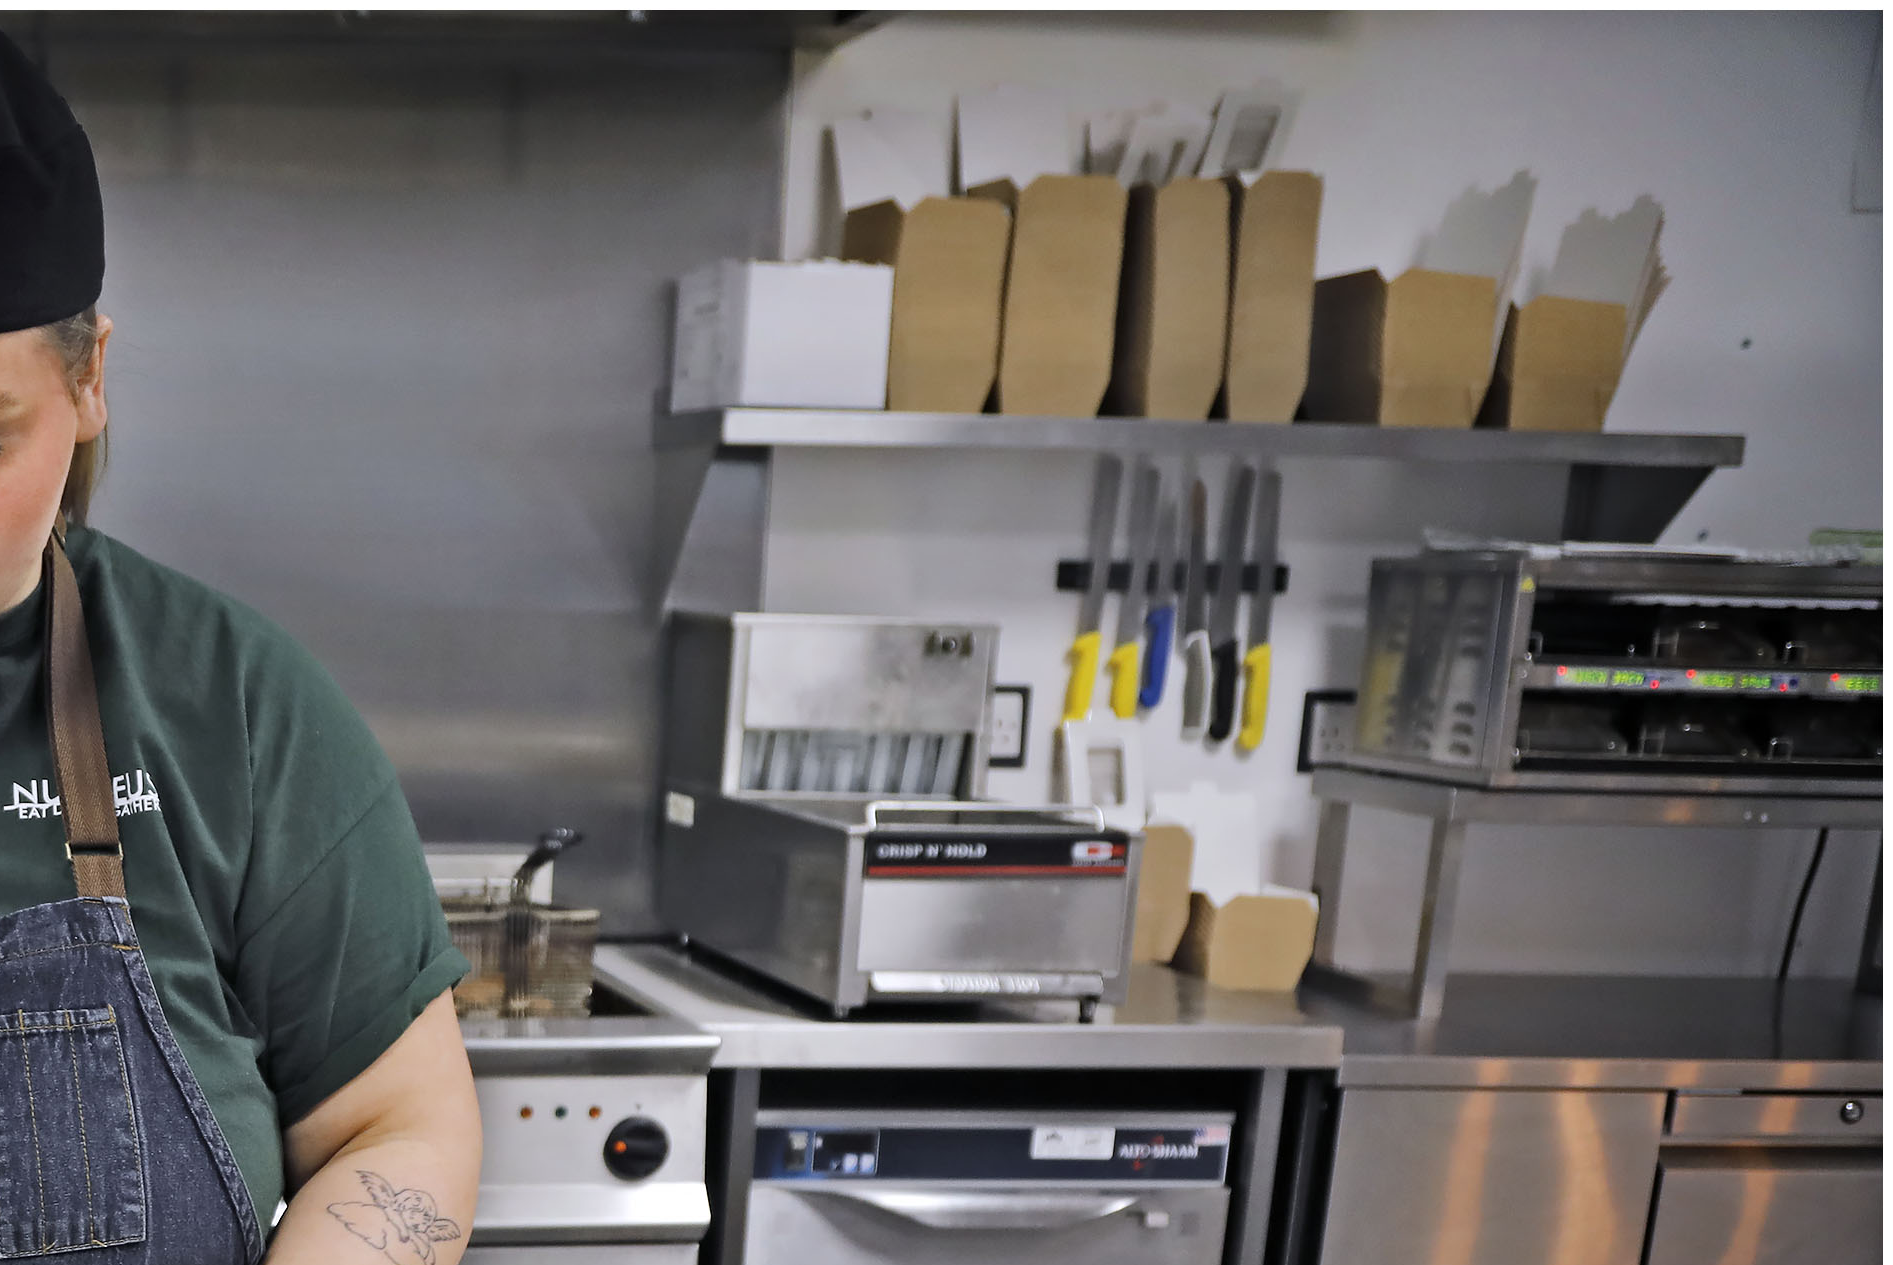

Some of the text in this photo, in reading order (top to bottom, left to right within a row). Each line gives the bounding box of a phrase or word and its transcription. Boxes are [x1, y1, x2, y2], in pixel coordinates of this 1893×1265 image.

[19, 806, 47, 819] EAT
[876, 843, 924, 860] CRISP
[945, 843, 988, 859] HOLD
